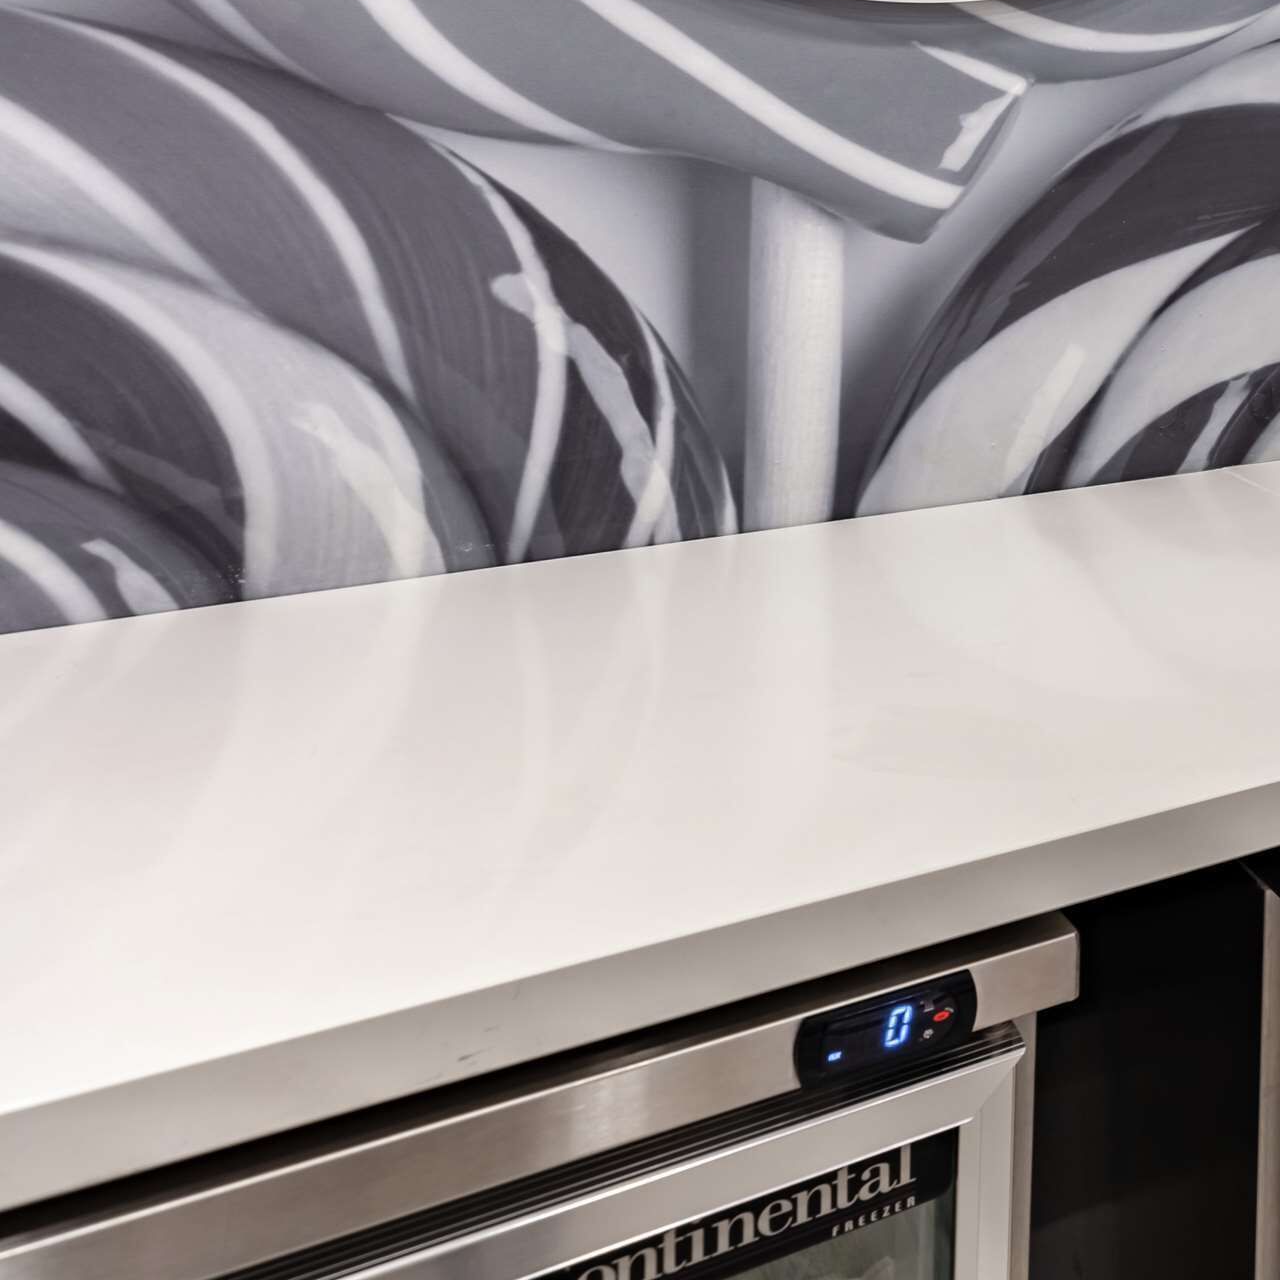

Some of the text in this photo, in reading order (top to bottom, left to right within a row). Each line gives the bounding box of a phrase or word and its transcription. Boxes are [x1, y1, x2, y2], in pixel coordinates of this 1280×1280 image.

[884, 1005, 914, 1048] 0
[565, 1143, 917, 1280] ontinental
[830, 1196, 917, 1238] FREEZER
